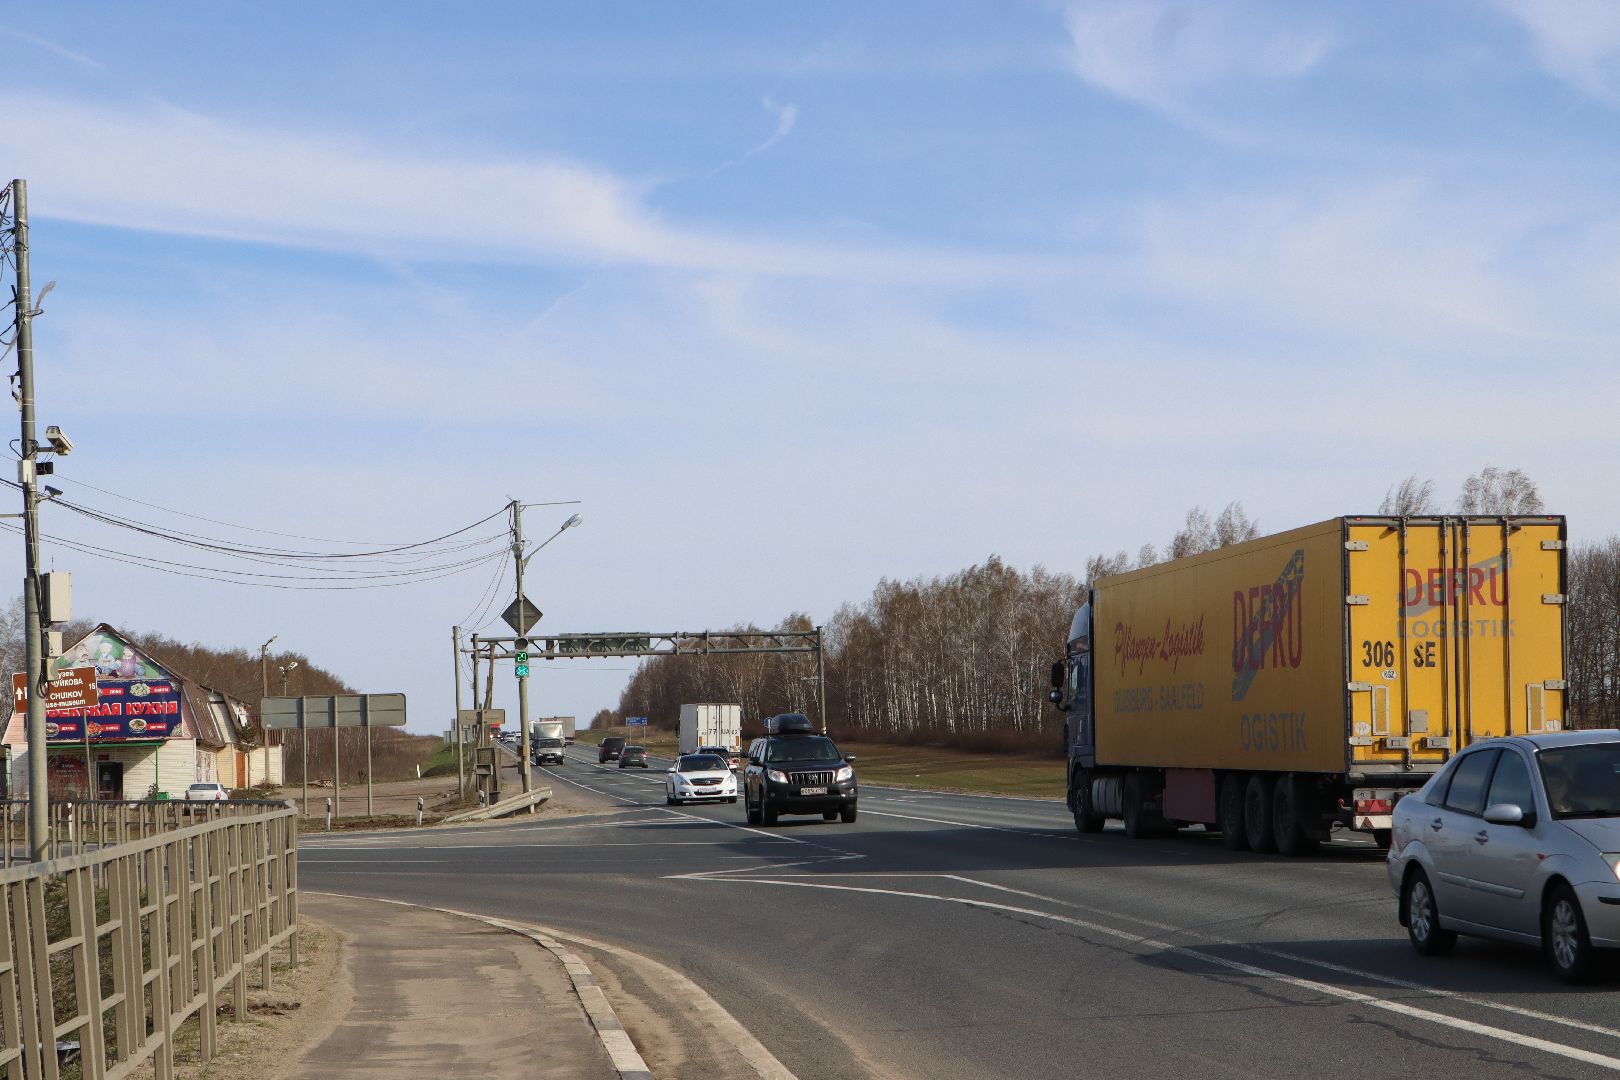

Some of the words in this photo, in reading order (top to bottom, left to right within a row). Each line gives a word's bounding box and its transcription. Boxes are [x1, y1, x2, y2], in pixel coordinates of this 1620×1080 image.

[1401, 568, 1510, 606] DEFRU
[1233, 579, 1303, 673] DEFRU
[1362, 640, 1395, 668] 306
[1413, 641, 1436, 668] SE
[57, 671, 75, 680] узей
[50, 690, 83, 700] CHUIKOV
[45, 699, 86, 708] use-museum
[126, 700, 178, 716] КУХНЯ
